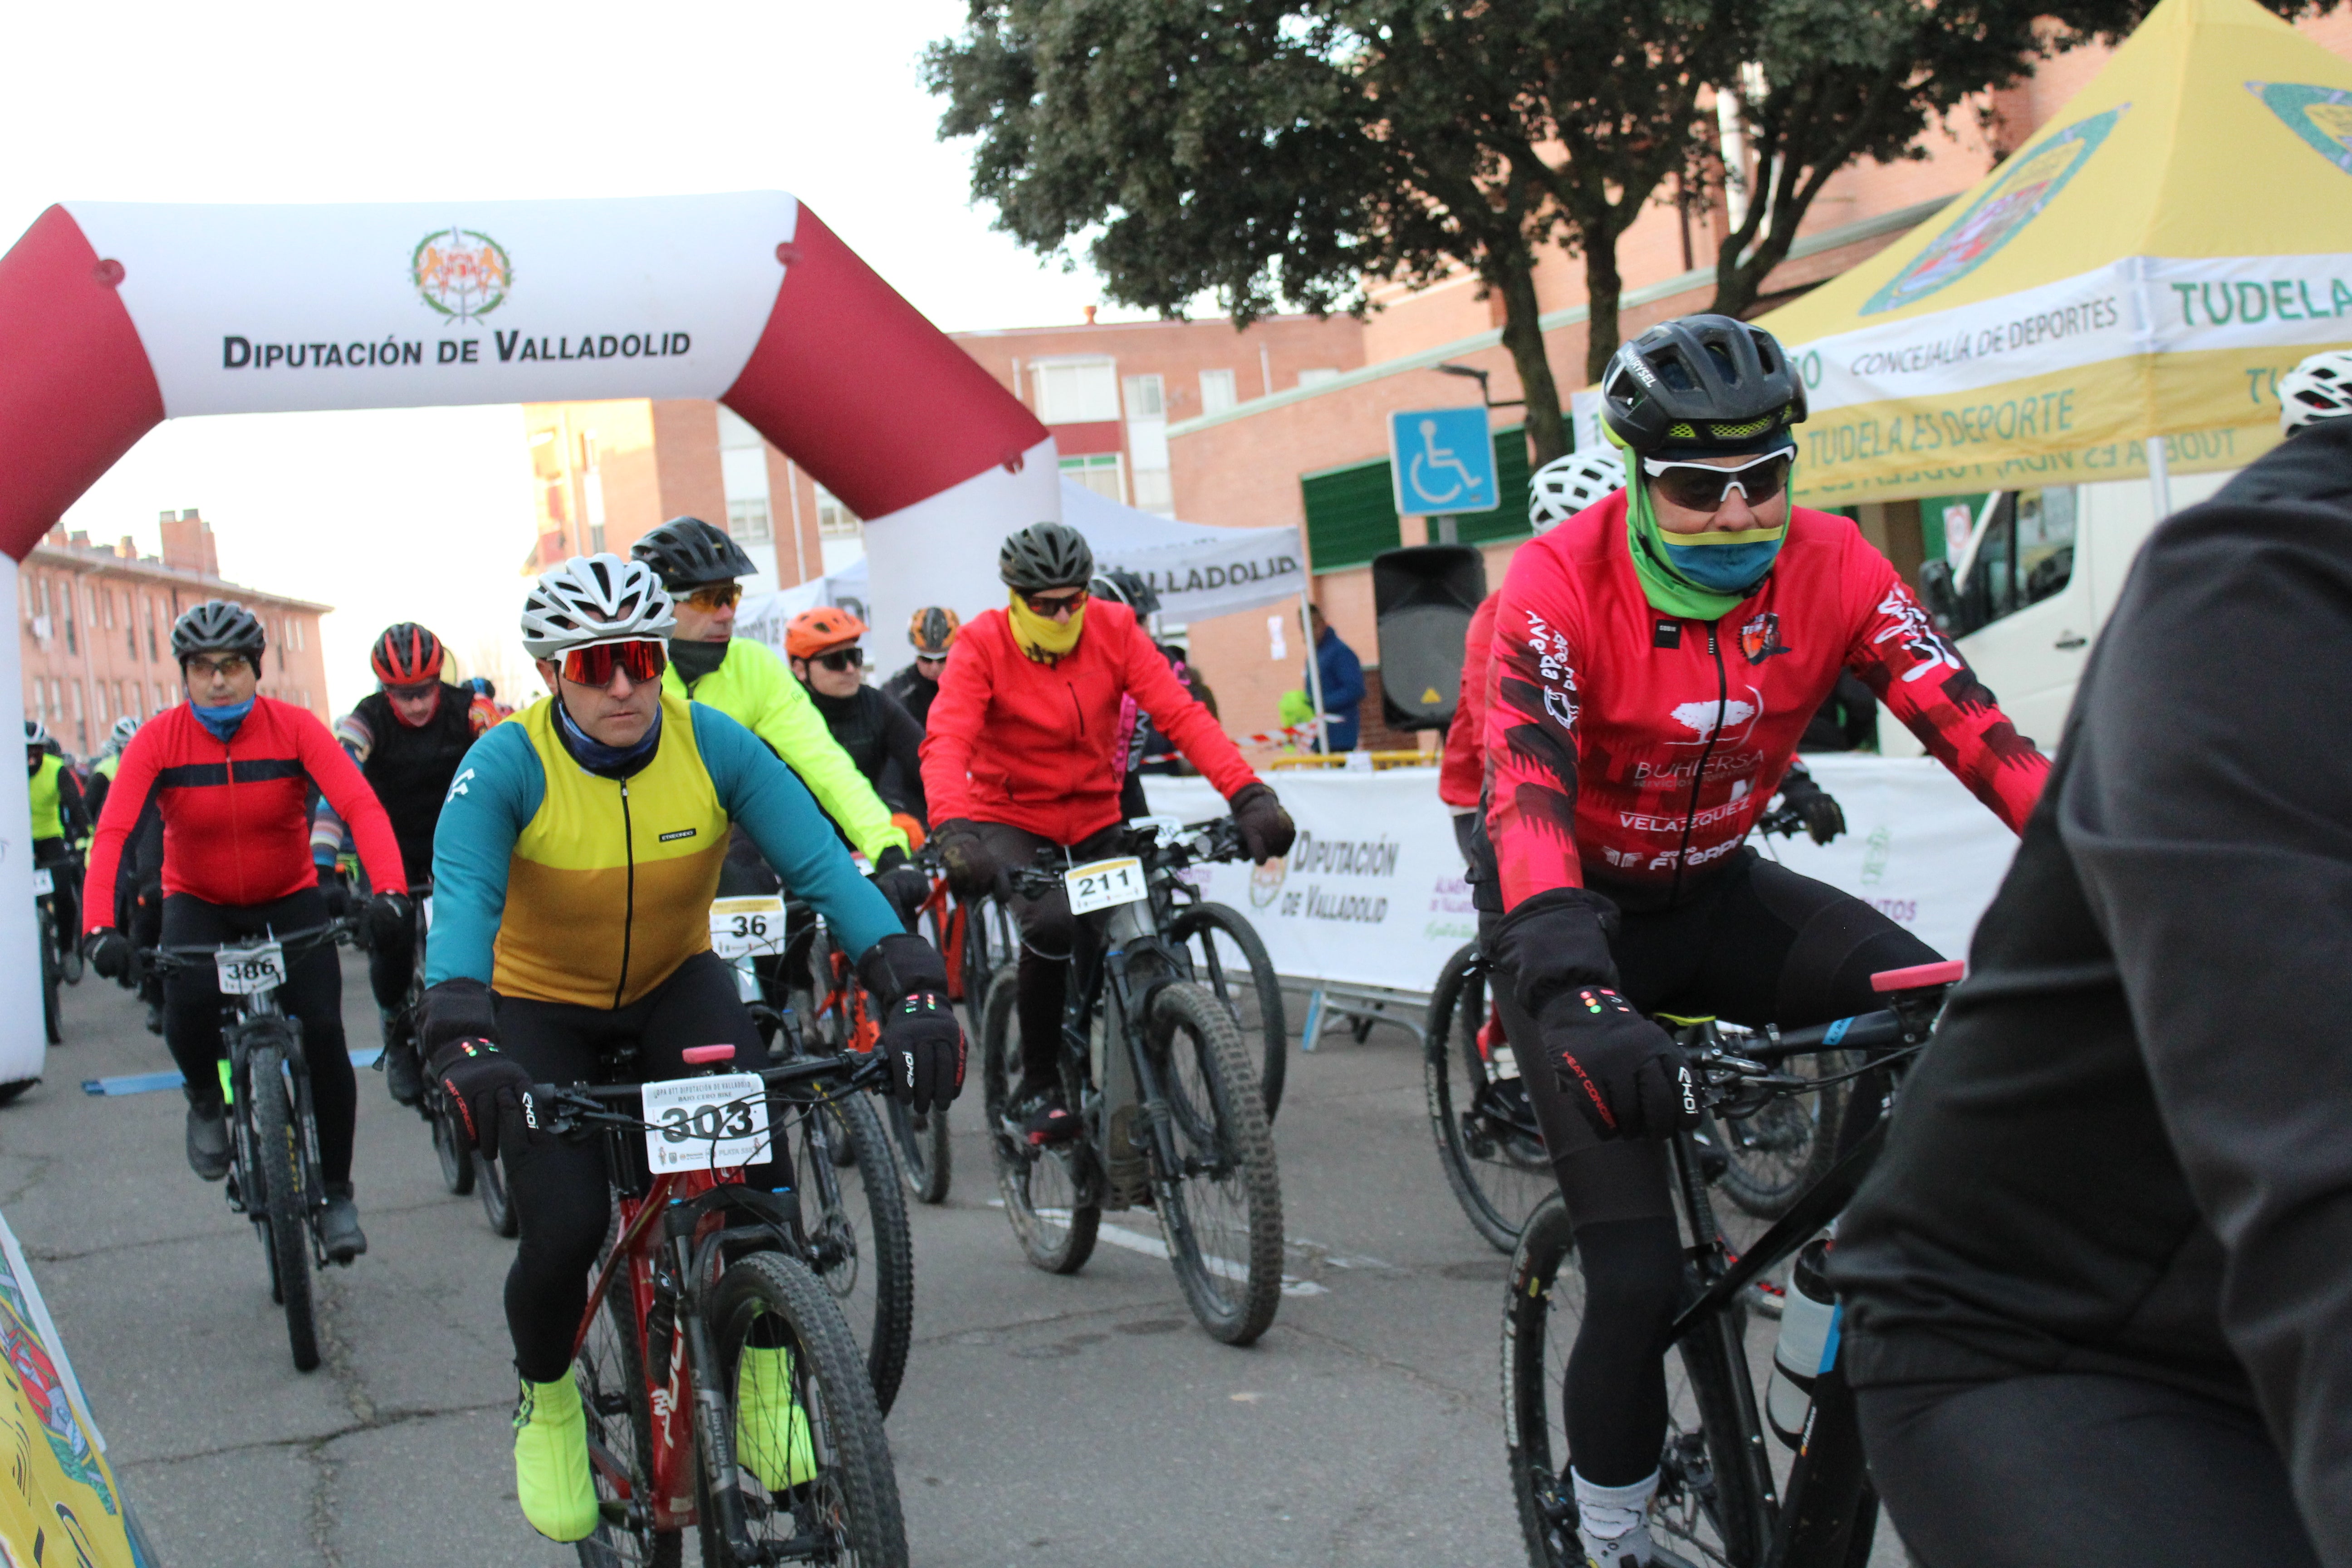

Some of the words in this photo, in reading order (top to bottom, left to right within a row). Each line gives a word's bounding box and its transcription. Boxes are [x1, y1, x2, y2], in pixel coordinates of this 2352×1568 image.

[2171, 278, 2352, 328] TUDELA
[223, 334, 422, 368] DIPUTACIÓN
[437, 339, 479, 363] DE
[494, 329, 691, 362] VALLADOLID
[1852, 329, 1971, 376] CONCEJALÍA
[1977, 326, 2003, 357] DE
[2008, 296, 2119, 349] DEPORTES
[1632, 359, 1656, 388] RYSEL
[1808, 415, 1902, 469] TUDELA
[1910, 413, 1942, 451] ES
[1942, 388, 2076, 446] DEPORTE
[1098, 555, 1298, 594] LLADOLID
[1293, 829, 1401, 877] DIPUTACIÓN
[1078, 868, 1129, 897] 211
[1281, 891, 1302, 916] DE
[1306, 884, 1389, 923] VALLADOLID
[731, 915, 767, 938] 36
[227, 957, 275, 980] 386
[1561, 1051, 1587, 1079] HEAT
[662, 1100, 753, 1143] 303
